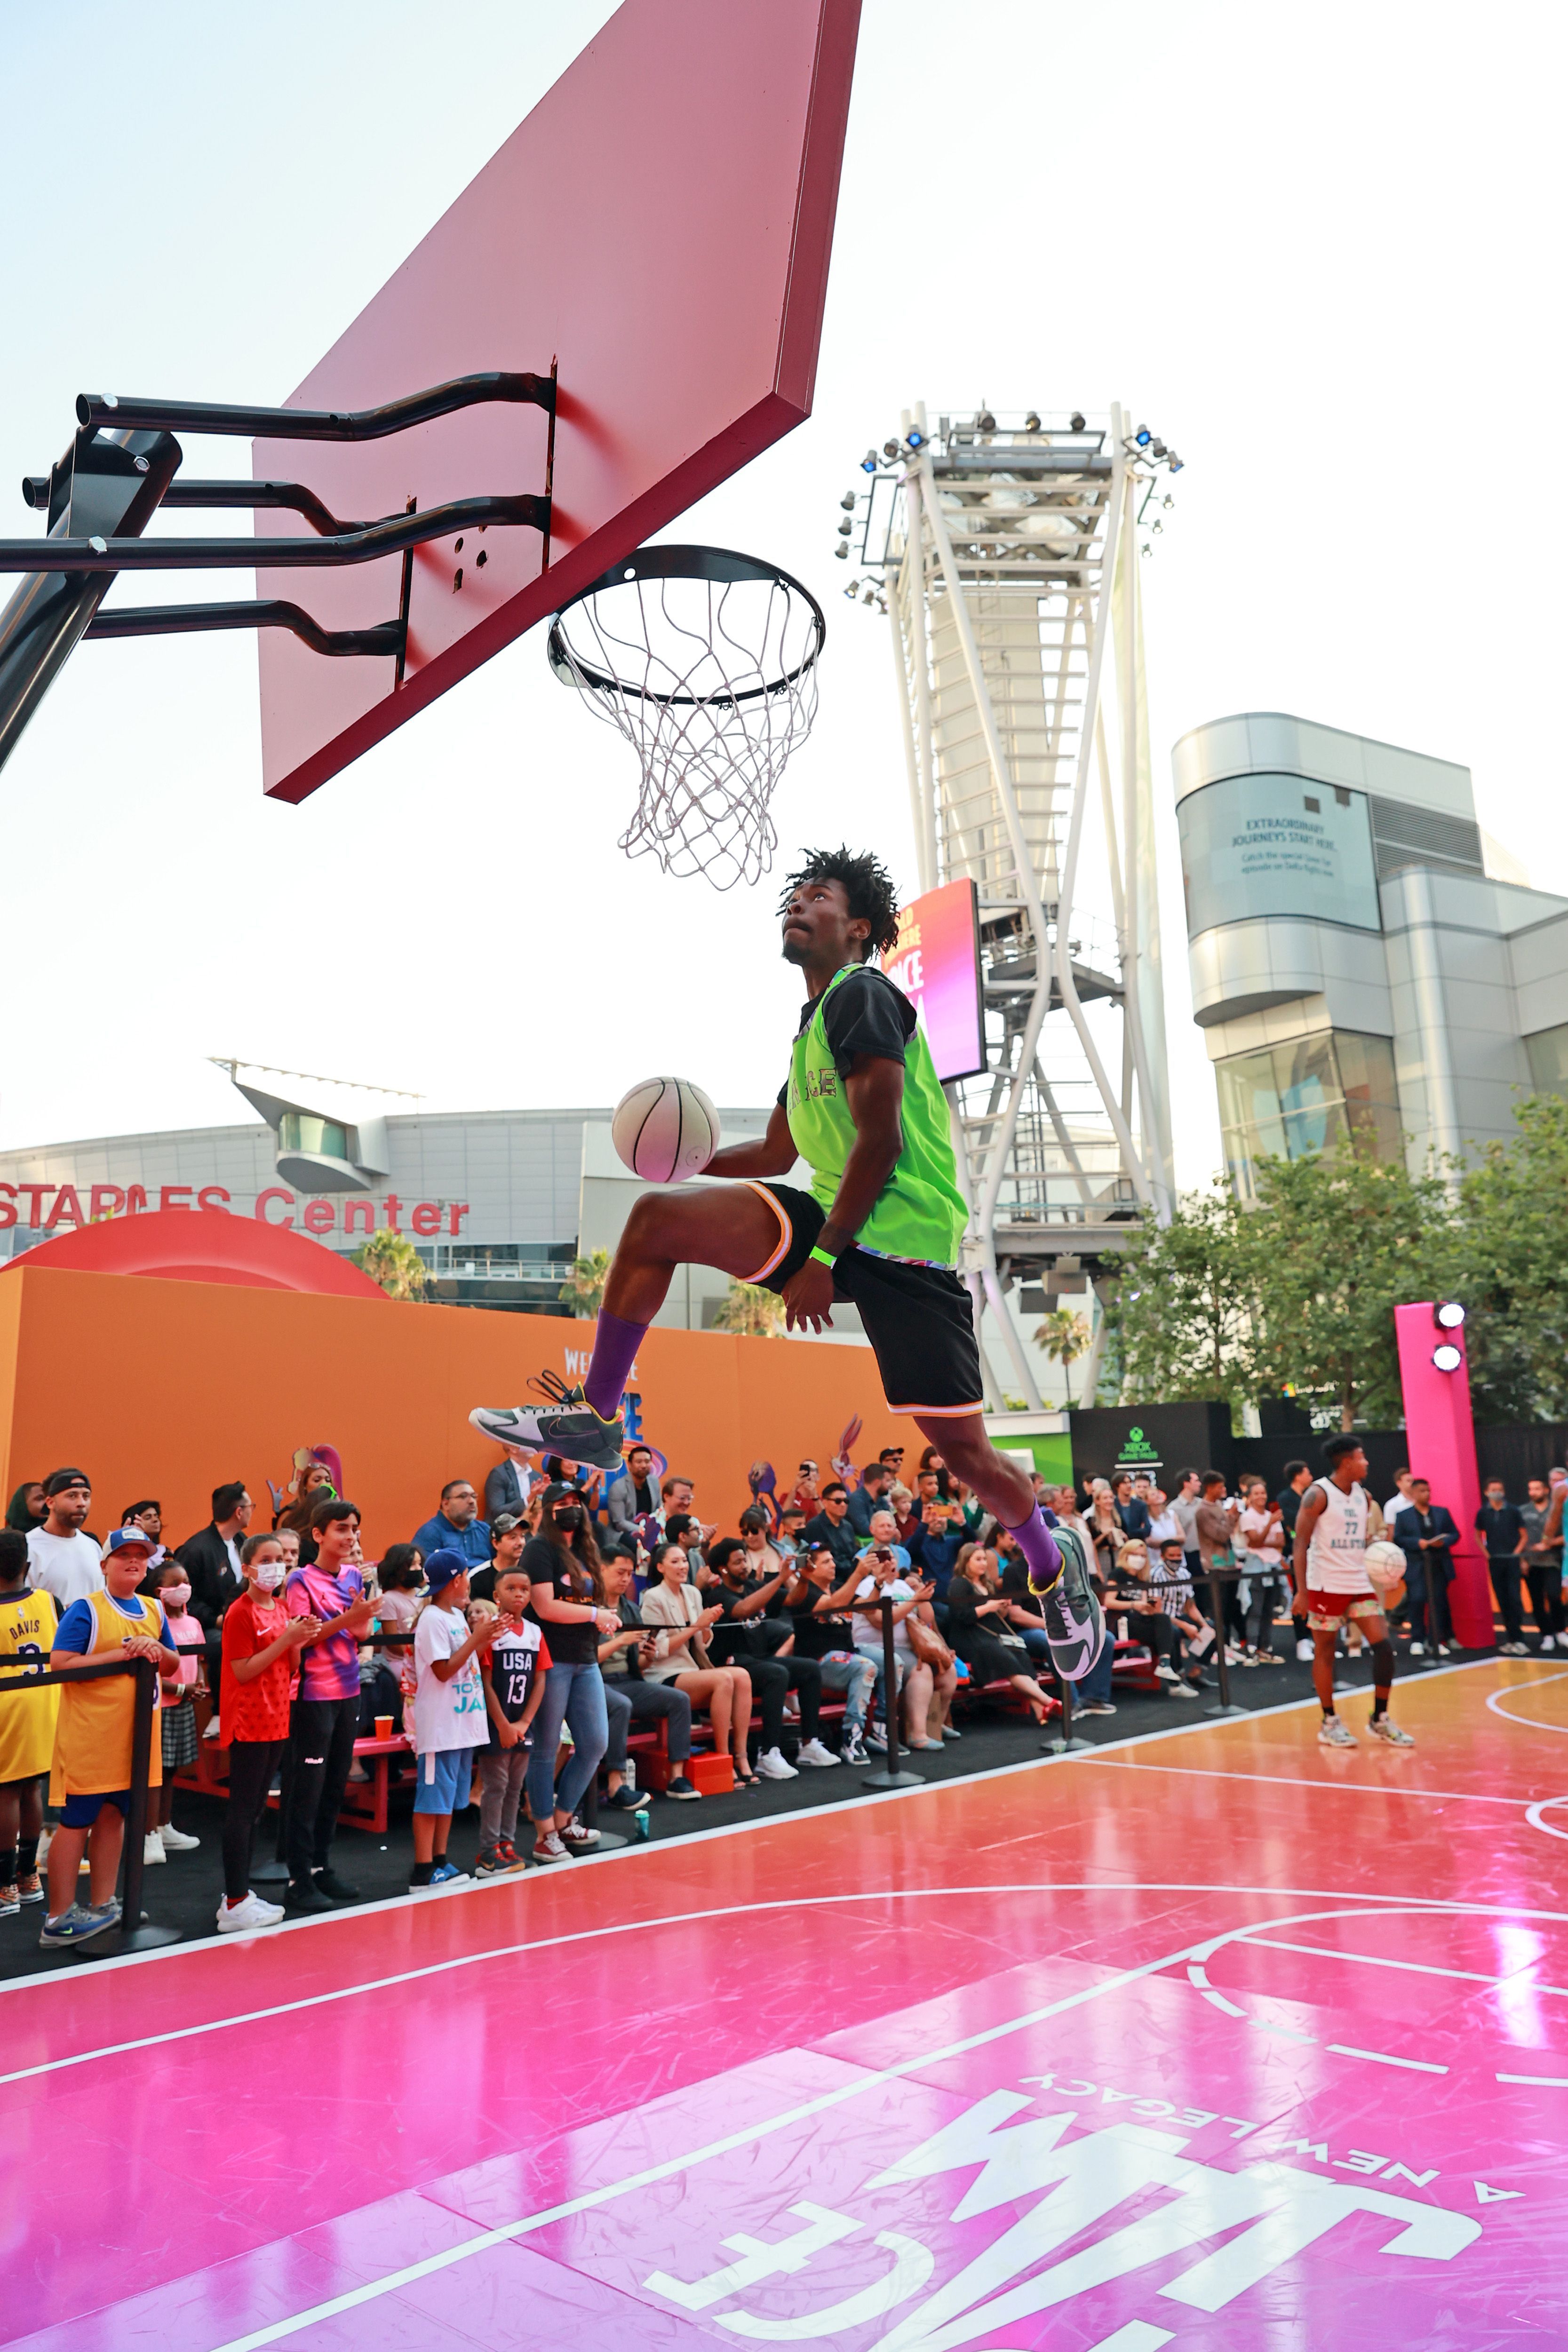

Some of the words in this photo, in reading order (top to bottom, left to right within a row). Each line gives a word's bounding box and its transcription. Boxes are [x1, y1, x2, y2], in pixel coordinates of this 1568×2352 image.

[1247, 818, 1324, 834] EXTRAORDINARY
[1232, 832, 1287, 848] JOURNEYS
[1288, 832, 1314, 845] START
[255, 1187, 470, 1236] Center
[1118, 1452, 1138, 1461] GAME
[1139, 1450, 1158, 1460] PASS
[1123, 1441, 1152, 1454] XBOX
[1345, 1522, 1358, 1534] 77
[9, 1620, 40, 1640] DAVIS
[503, 1652, 533, 1671] USA
[452, 1683, 473, 1694] TO
[507, 1674, 527, 1704] 13
[1018, 2072, 1261, 2140] LEGACY
[1269, 2137, 1441, 2189] NEW
[1473, 2179, 1527, 2205] A
